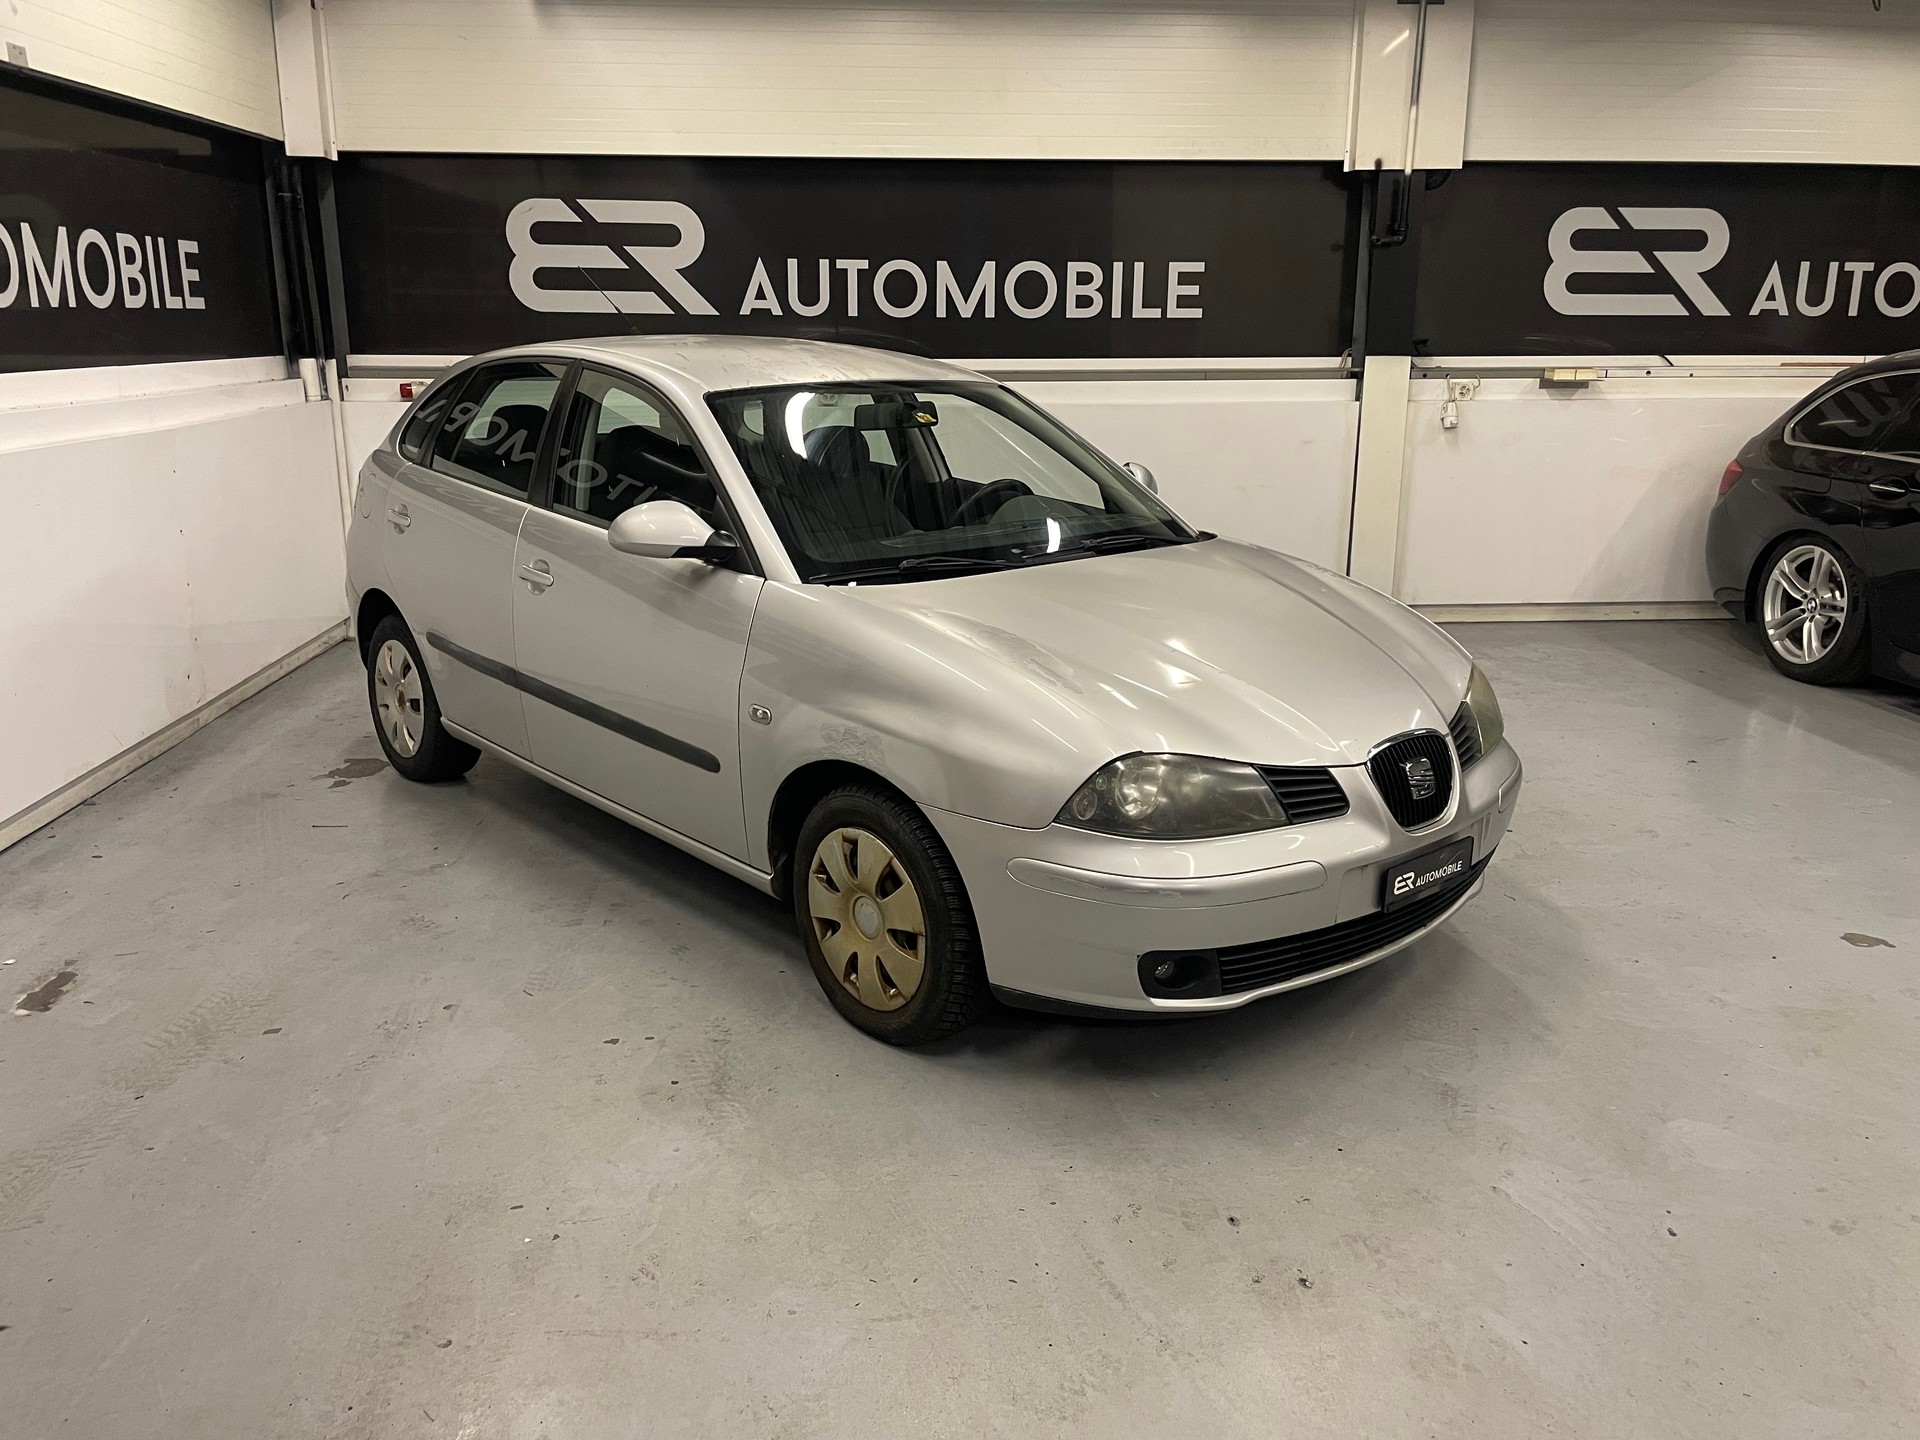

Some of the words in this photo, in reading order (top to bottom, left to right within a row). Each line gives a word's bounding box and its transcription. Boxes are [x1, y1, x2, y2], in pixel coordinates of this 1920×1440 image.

[739, 256, 1206, 319] AUTOMOBILE
[1748, 260, 1920, 318] AUTO
[1415, 860, 1463, 887] AUTOMOBILE
